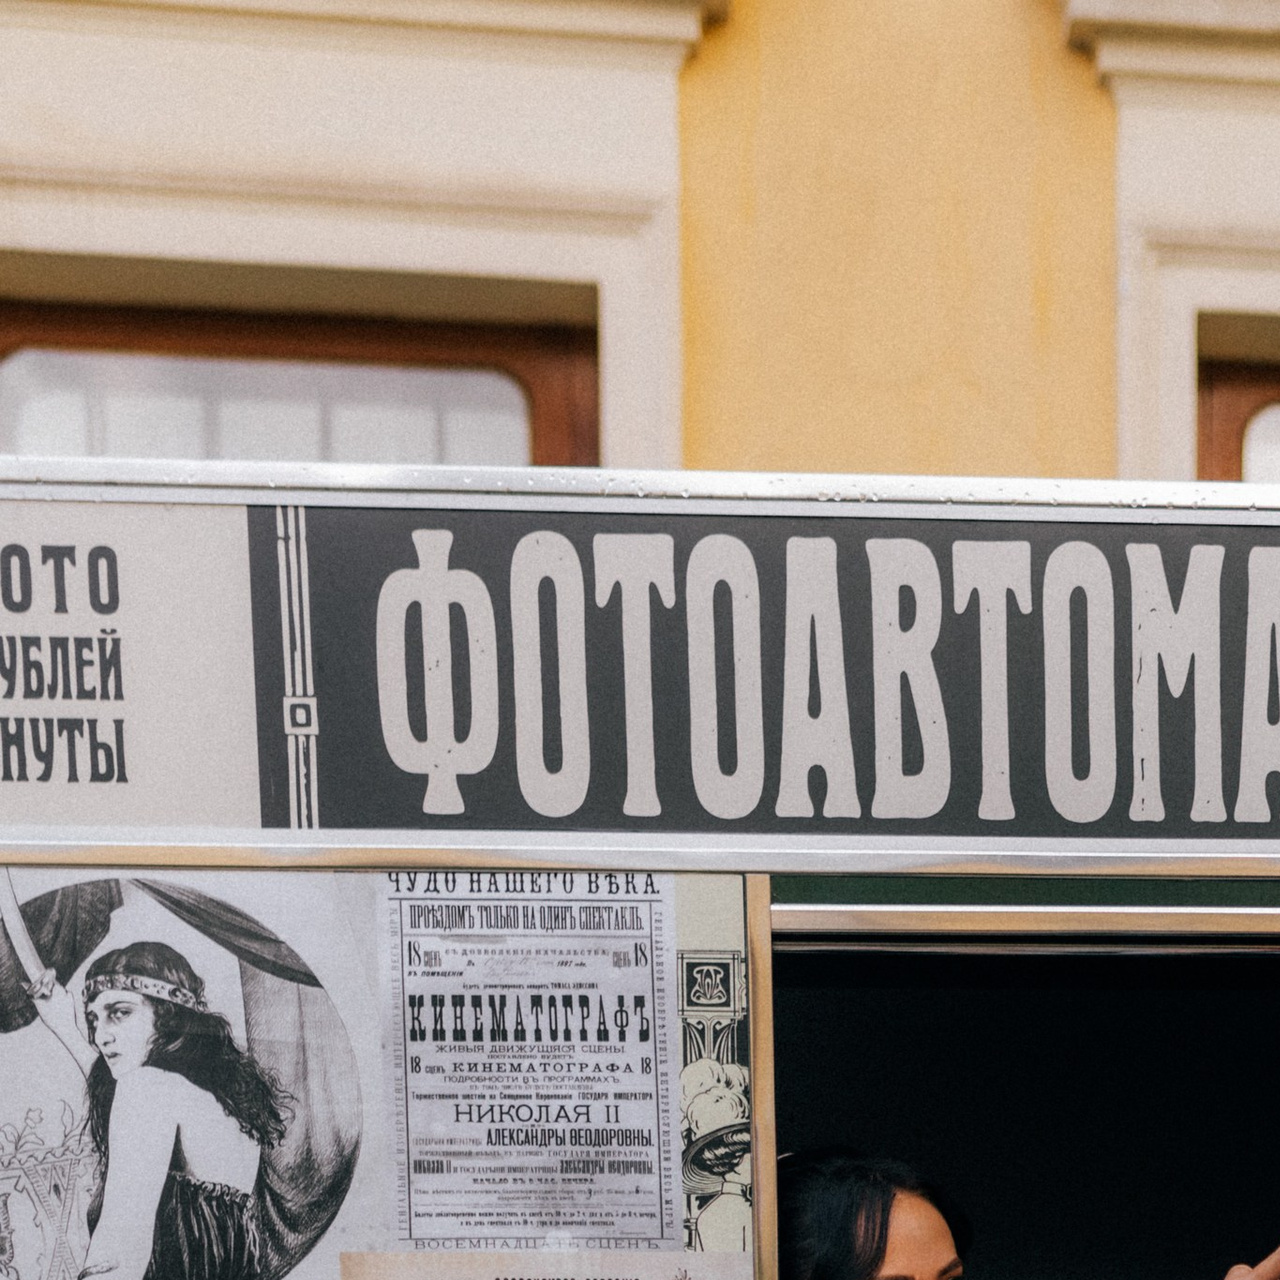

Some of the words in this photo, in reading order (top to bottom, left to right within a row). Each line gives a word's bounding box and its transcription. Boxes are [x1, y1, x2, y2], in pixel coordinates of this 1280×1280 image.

[0, 543, 120, 616] ОТО
[0, 628, 125, 701] УБЛЕЙ
[0, 716, 129, 784] НУТЫ
[388, 873, 457, 894] ЧУДО
[469, 873, 574, 894] НАШЕГО
[477, 905, 520, 930] ТОЛЬКО
[522, 905, 537, 930] НА
[539, 906, 575, 932] ОДИНЪ
[407, 940, 421, 967] 18
[634, 942, 649, 968] 18
[408, 994, 650, 1042] КИНЕМАТОГРАФЪ
[410, 1056, 422, 1074] 18
[452, 1061, 634, 1074] КИНЕМАТОГРАФА
[641, 1057, 652, 1075] 18
[454, 1104, 592, 1124] НИКОЛАЯ
[486, 1128, 567, 1148] АЛЕКСАНДРЫ
